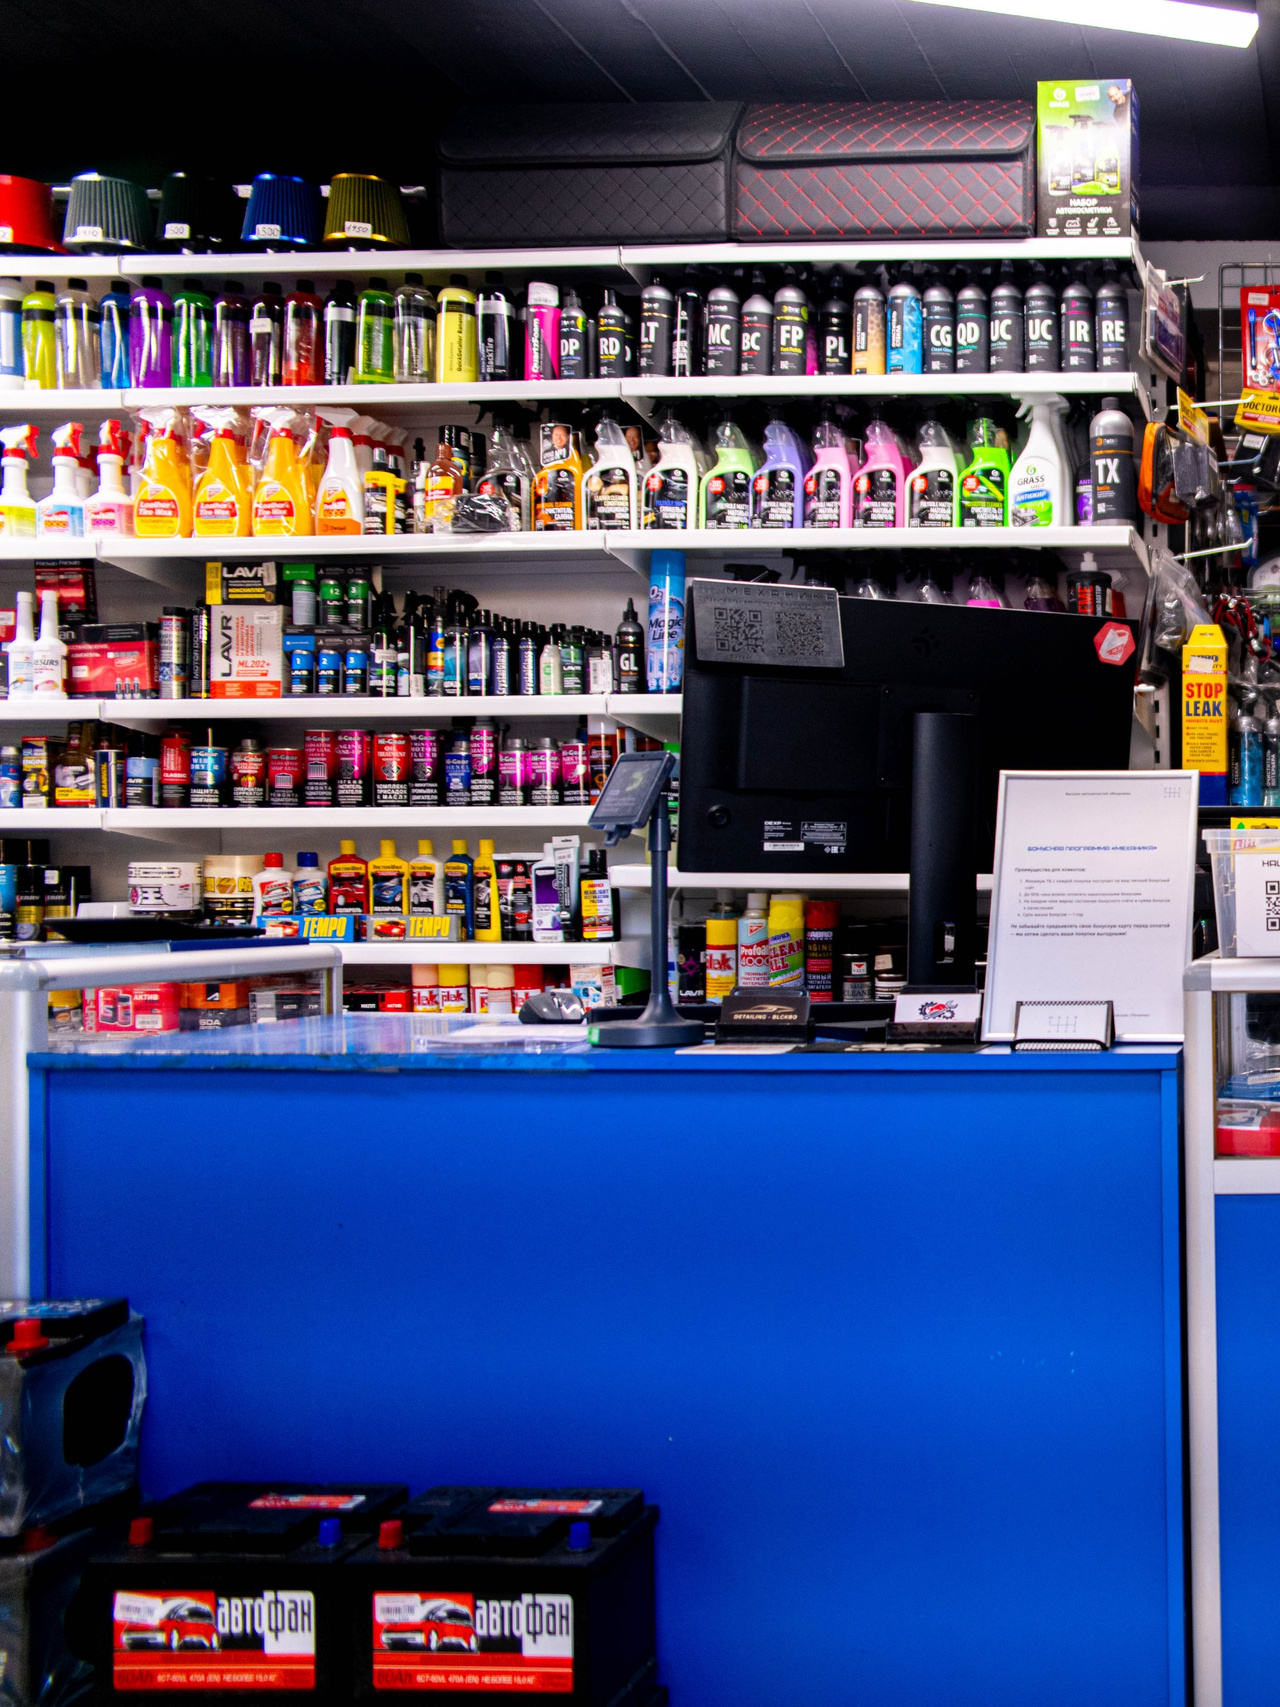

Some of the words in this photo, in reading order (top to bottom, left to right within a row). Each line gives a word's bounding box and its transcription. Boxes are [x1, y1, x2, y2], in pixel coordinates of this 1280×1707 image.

[641, 321, 659, 343] LT
[708, 324, 731, 345] MC
[780, 325, 804, 346] FP
[930, 324, 953, 347] CG
[957, 321, 980, 346] QD
[990, 319, 1012, 341] UC
[1029, 319, 1053, 341] UC
[1069, 320, 1090, 342] IR
[1102, 320, 1125, 342] RE
[532, 318, 540, 373] QuartzFoam
[561, 339, 580, 356] DP
[600, 337, 620, 355] RD
[742, 332, 761, 350] BC
[826, 336, 848, 358] PL
[1018, 475, 1045, 486] GRASS
[1095, 458, 1120, 484] TX
[1016, 491, 1046, 501] АНТИЖИР
[221, 615, 232, 677] LAVR
[237, 660, 270, 668] ML202+
[620, 653, 638, 671] GL
[496, 651, 504, 695] CrystalGlass
[523, 651, 532, 695] CrystalGlass
[1186, 683, 1223, 698] STOP
[1186, 701, 1222, 717] LEAK
[303, 917, 347, 937] TEMPO
[409, 917, 450, 937] TEMPO
[769, 939, 803, 957] CLEAN
[769, 957, 789, 973] ALL
[217, 1592, 311, 1641] автофан
[476, 1594, 569, 1644] автофан
